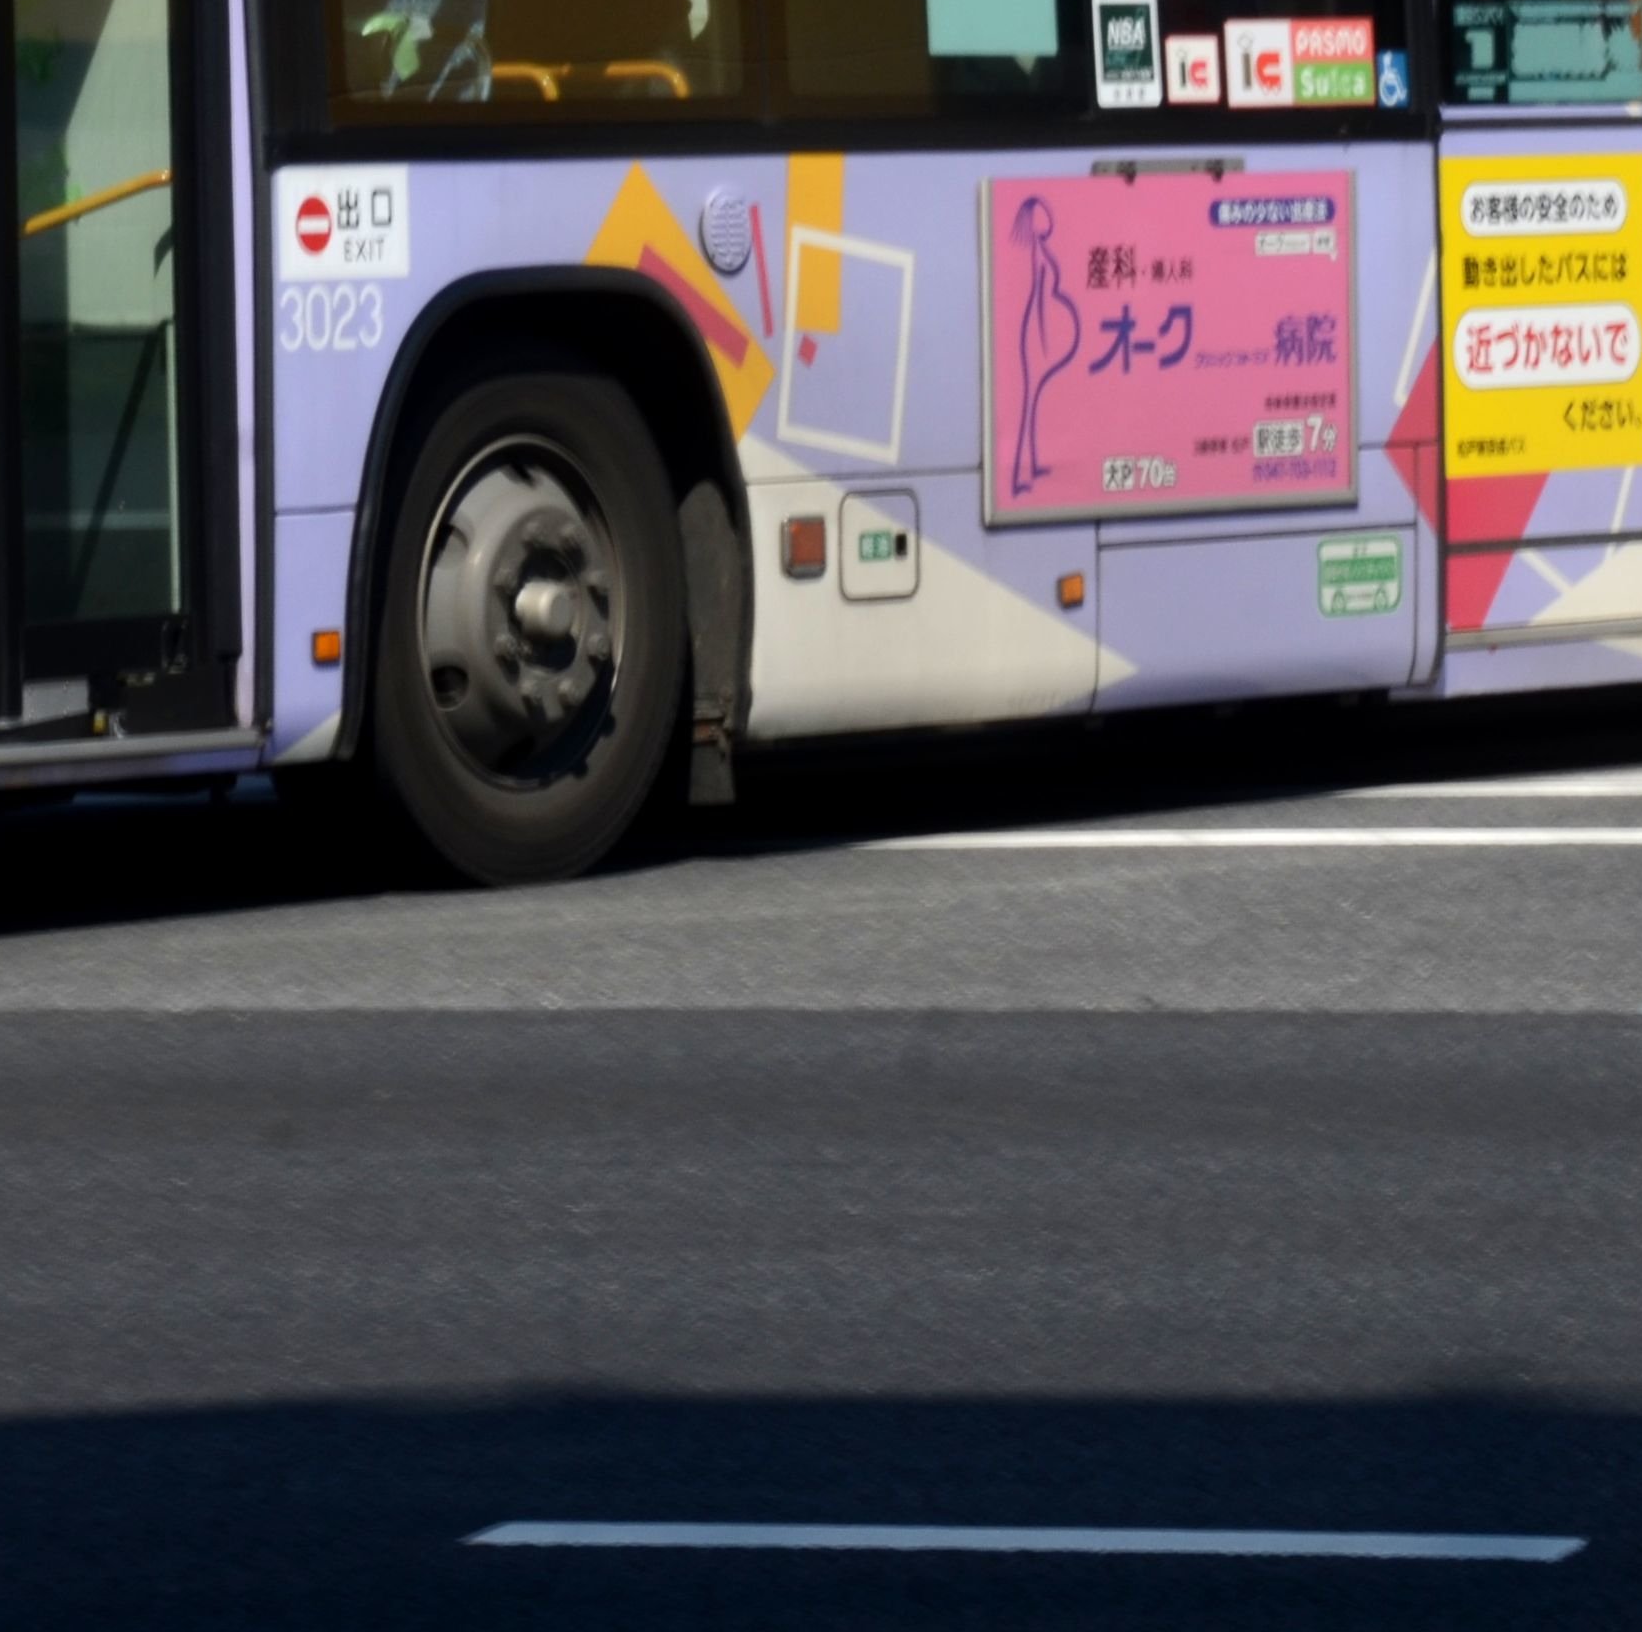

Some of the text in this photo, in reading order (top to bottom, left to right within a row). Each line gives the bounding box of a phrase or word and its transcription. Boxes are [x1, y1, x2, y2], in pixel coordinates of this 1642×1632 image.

[1295, 26, 1367, 58] PASMO
[1299, 67, 1366, 99] Suica
[336, 185, 394, 231] 出口
[1469, 191, 1619, 224] お客様の安全のため
[343, 237, 385, 262] EXIT
[1462, 252, 1628, 290] 動き出したバスには
[279, 281, 384, 352] 3023
[1088, 303, 1194, 374] オーク
[1274, 314, 1337, 366] 病院
[1467, 323, 1629, 373] 近づかないで
